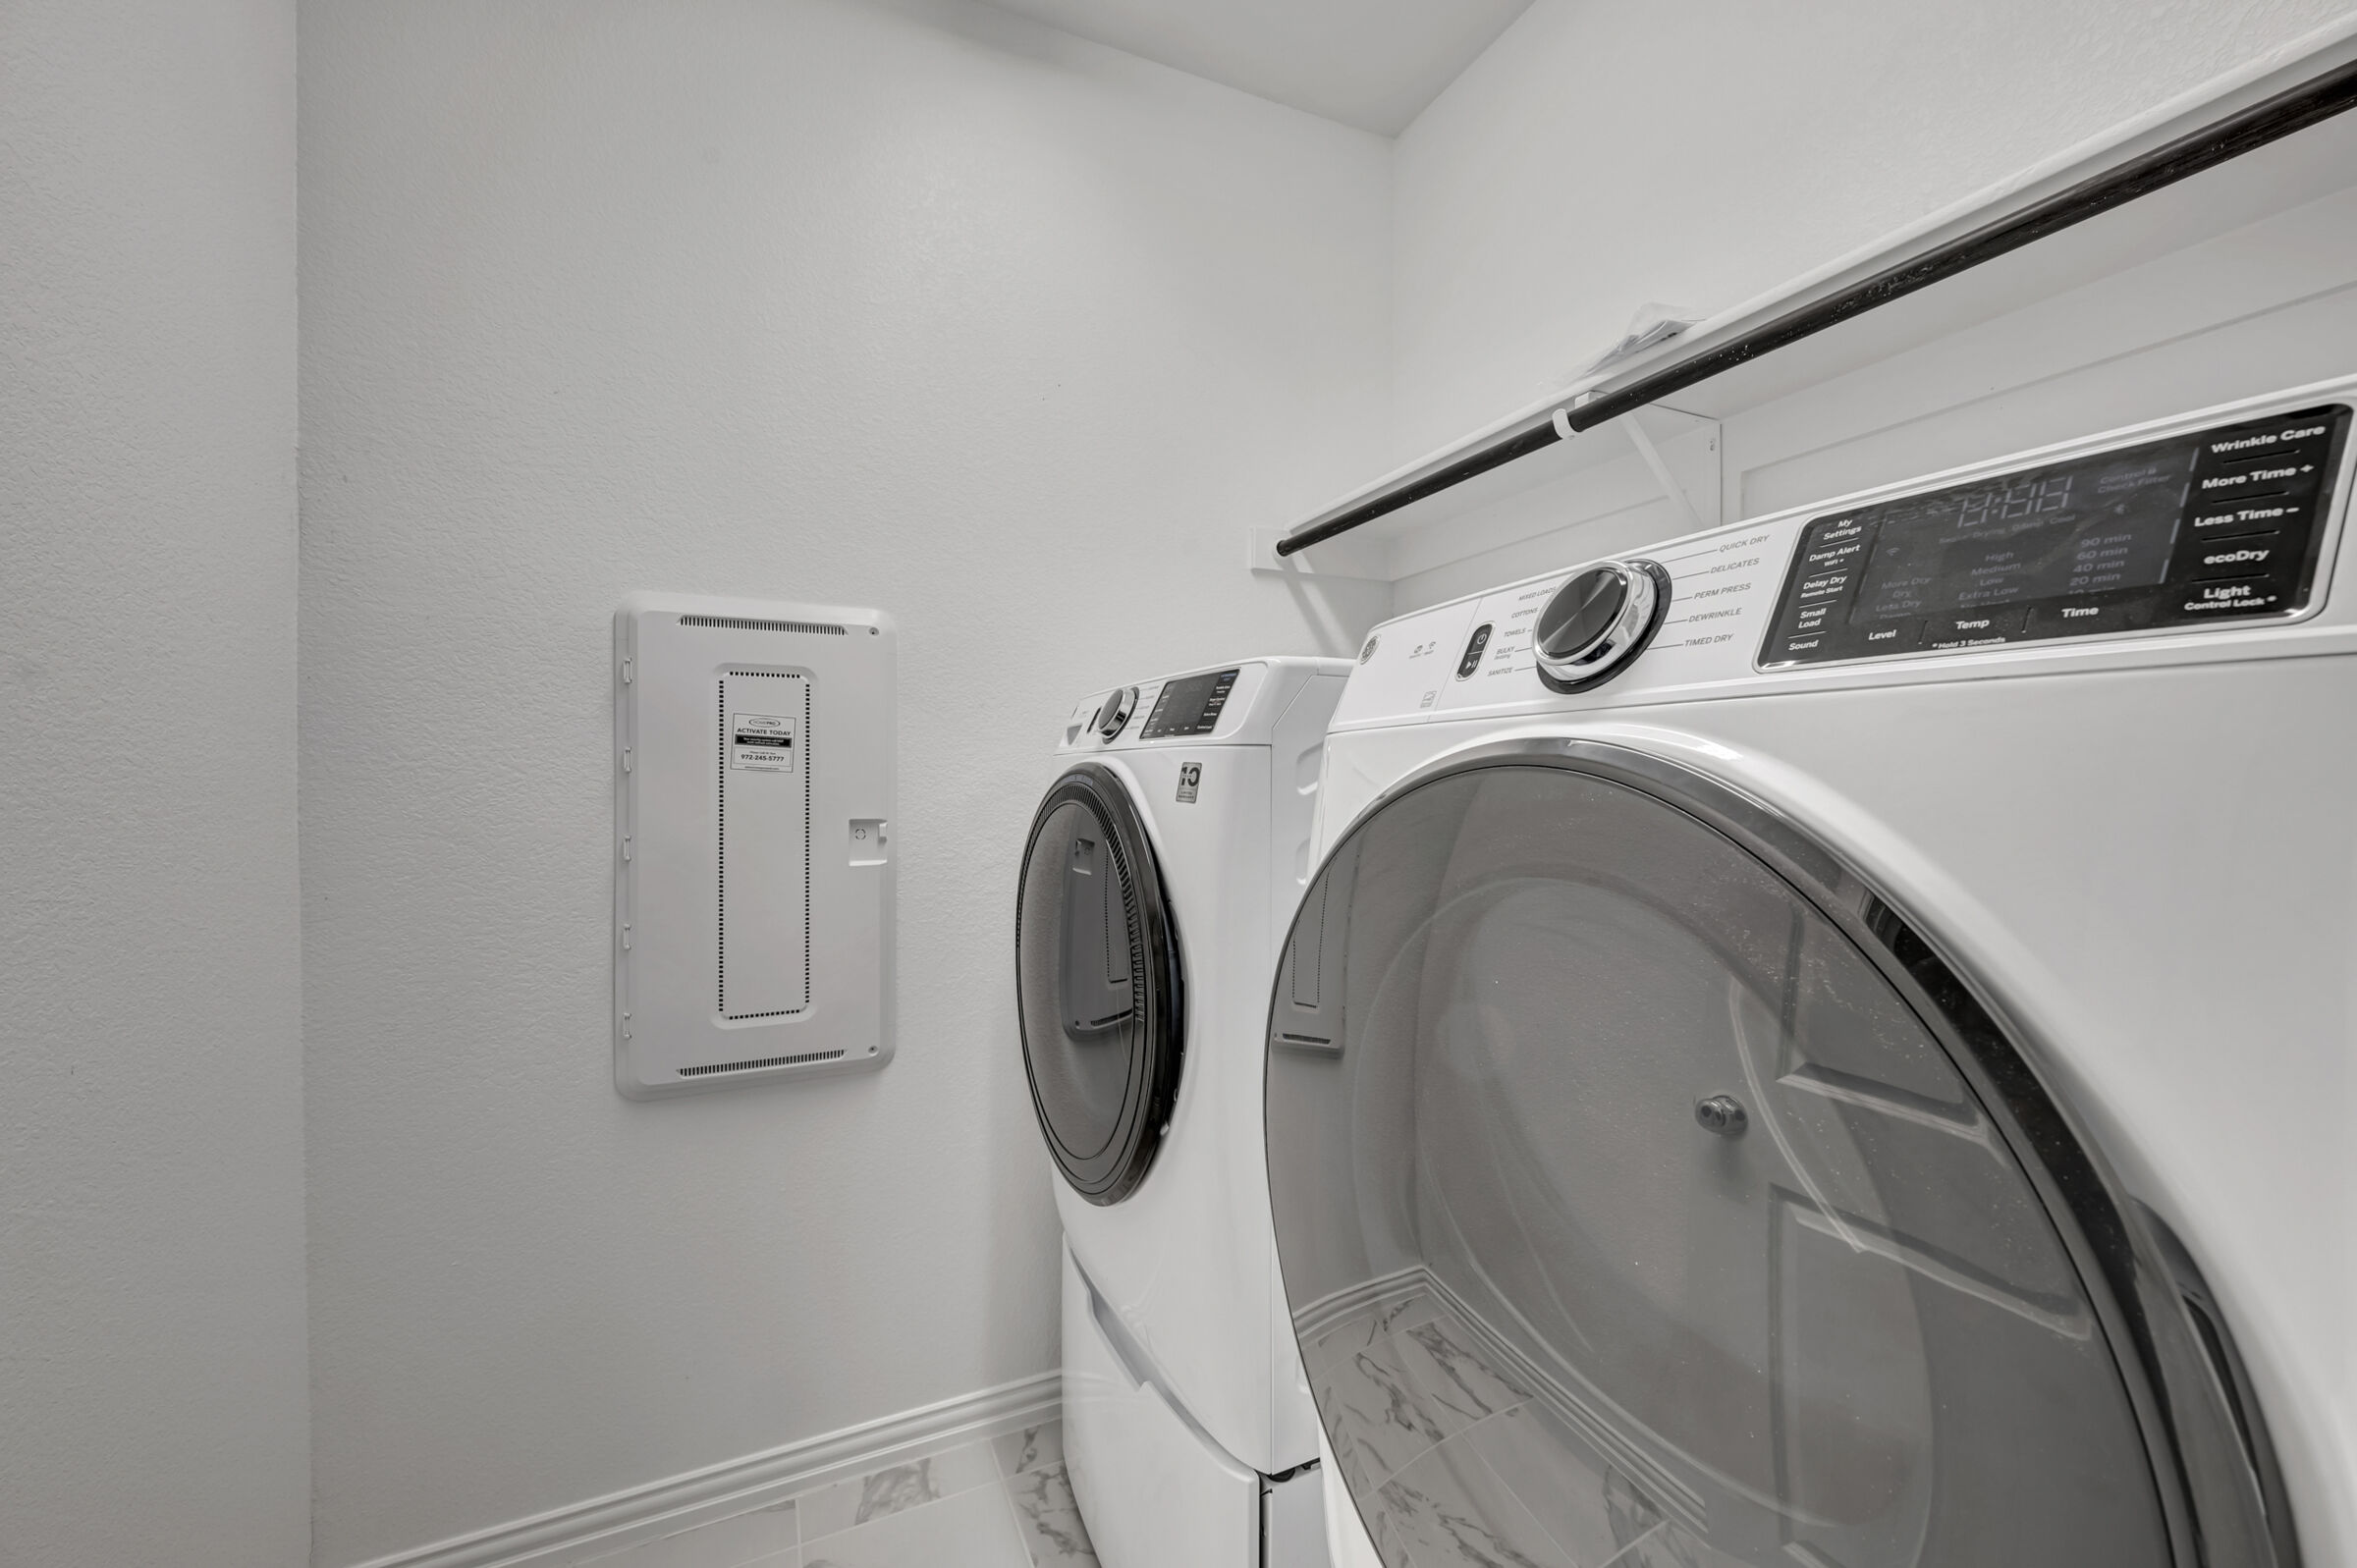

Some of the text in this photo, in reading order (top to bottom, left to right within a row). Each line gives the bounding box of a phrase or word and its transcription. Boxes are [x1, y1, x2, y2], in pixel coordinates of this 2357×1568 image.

[2211, 425, 2327, 454] Wrinkle Care
[2100, 470, 2146, 485] Control
[2202, 475, 2247, 489] More
[2249, 466, 2297, 482] Time
[1837, 519, 1853, 528] My
[2194, 514, 2234, 527] Less
[2236, 507, 2283, 520] Time
[1823, 526, 1862, 540] Settings
[1719, 534, 1770, 553] QUICK DRY
[2080, 533, 2132, 549] 90 min
[1809, 544, 1861, 562] Damp Alert
[1985, 551, 2014, 563] High
[2076, 546, 2128, 561] 60 min
[2204, 550, 2270, 565] ecoDry
[1710, 558, 1760, 574] DELICATES
[1971, 562, 2021, 576] Medium
[2072, 559, 2125, 573] 40 min
[1803, 575, 1847, 590] Delay Dry
[1881, 580, 1909, 590] More
[1980, 576, 2004, 587] Low
[2069, 572, 2121, 586] 20 min
[1694, 582, 1752, 600] PERM PRESS
[1826, 585, 1843, 594] Start
[1892, 590, 1911, 600] Dry
[1958, 586, 2019, 601] Extra Low
[2204, 585, 2251, 600] Light
[1901, 600, 1922, 609] Dry
[2184, 597, 2266, 611] Control Lock
[1511, 607, 1538, 619] COTTONS
[1688, 607, 1742, 622] DEWRINKLE
[1800, 608, 1827, 619] Small
[2061, 606, 2100, 619] Time
[1798, 618, 1822, 629] Load
[1955, 619, 1990, 629] Temp
[1684, 633, 1734, 647] TIMED DRY
[1868, 629, 1897, 640] Level
[1967, 636, 2005, 647] Seconds
[1788, 639, 1819, 651] Sound
